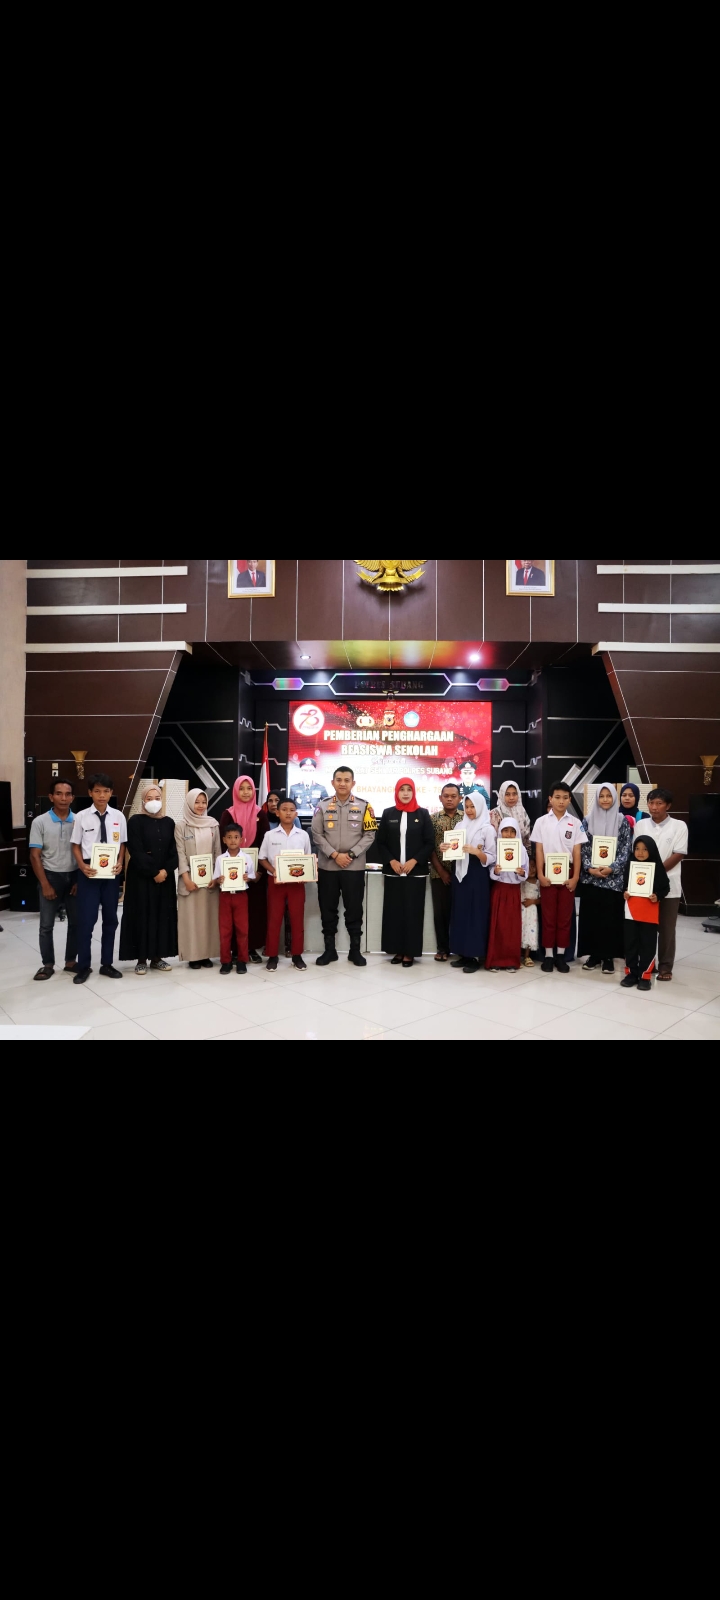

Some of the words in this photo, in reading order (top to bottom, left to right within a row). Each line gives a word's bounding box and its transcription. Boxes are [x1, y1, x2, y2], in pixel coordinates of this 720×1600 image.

[323, 729, 380, 741] PEMBERIAN
[381, 730, 454, 742] PENGHARGAAN
[341, 744, 393, 755] BEASISWA
[394, 745, 438, 756] SEKOLAH
[399, 767, 426, 775] POLRES
[426, 767, 453, 775] SUBANG
